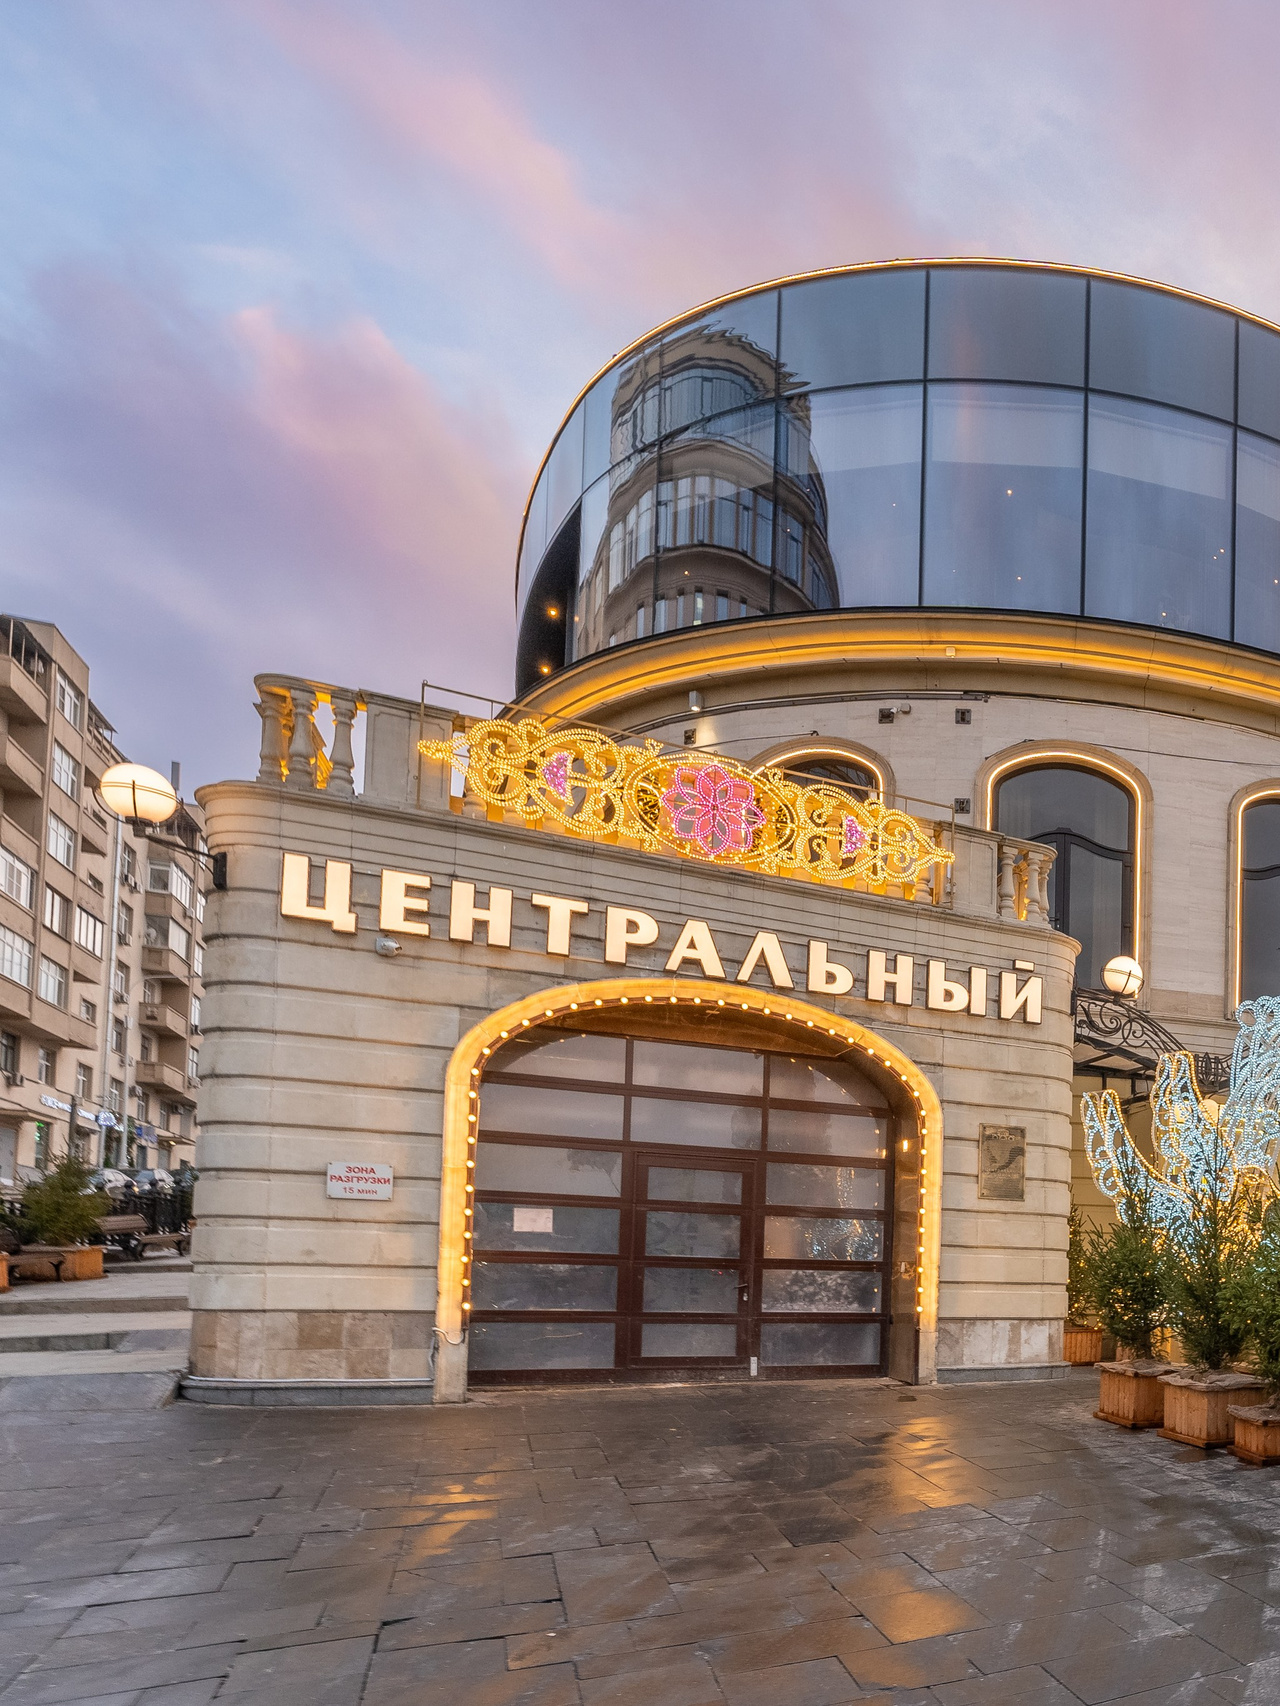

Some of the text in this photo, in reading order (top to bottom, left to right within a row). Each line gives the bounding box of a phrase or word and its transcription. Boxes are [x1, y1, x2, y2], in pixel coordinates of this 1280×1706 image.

[280, 851, 1043, 1025] ЦЕНТРАЛЬНЫЙ
[345, 1166, 376, 1174] ЗОНА
[330, 1175, 391, 1185] РАЗГРУЗКИ
[343, 1186, 355, 1194] 15
